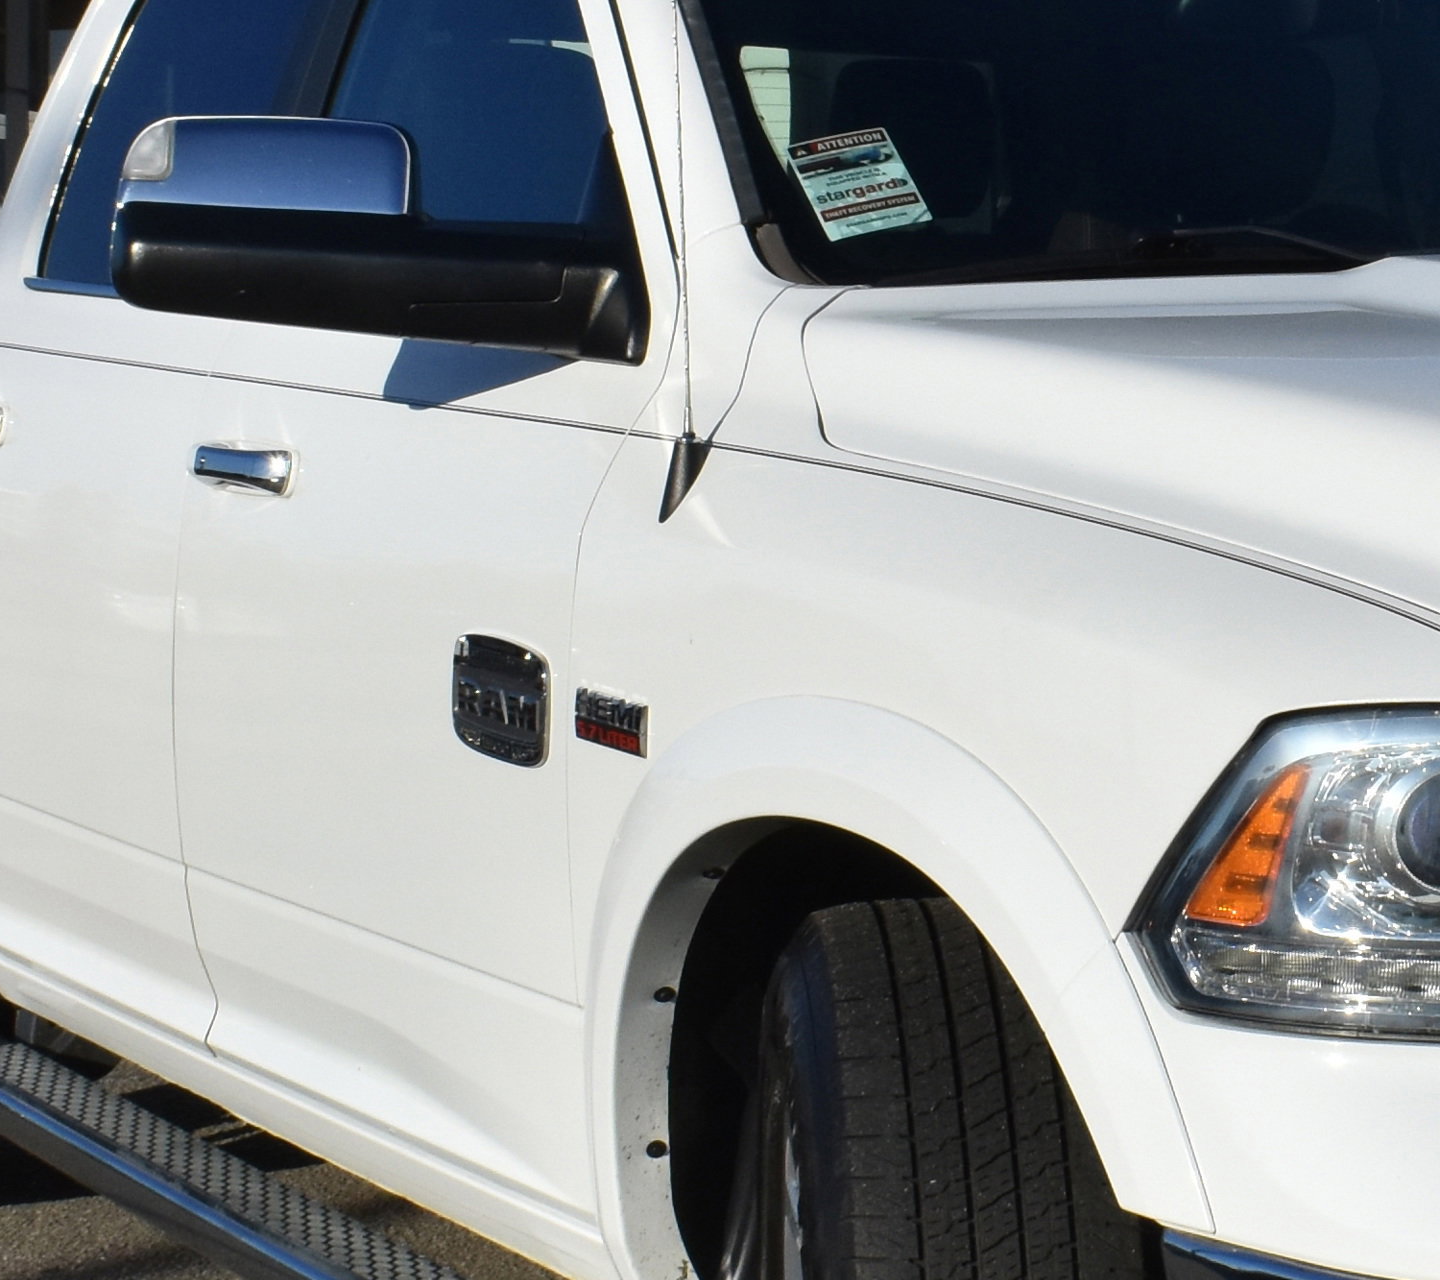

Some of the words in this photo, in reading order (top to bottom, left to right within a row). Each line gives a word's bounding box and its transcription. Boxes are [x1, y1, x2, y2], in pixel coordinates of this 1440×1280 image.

[817, 132, 883, 152] ATTENTION
[816, 178, 898, 204] stargard
[824, 208, 847, 220] THEFT
[847, 200, 886, 215] RECOVERY
[886, 194, 917, 206] SYSTEM
[458, 676, 541, 734] RAM
[575, 687, 645, 733] HEMI
